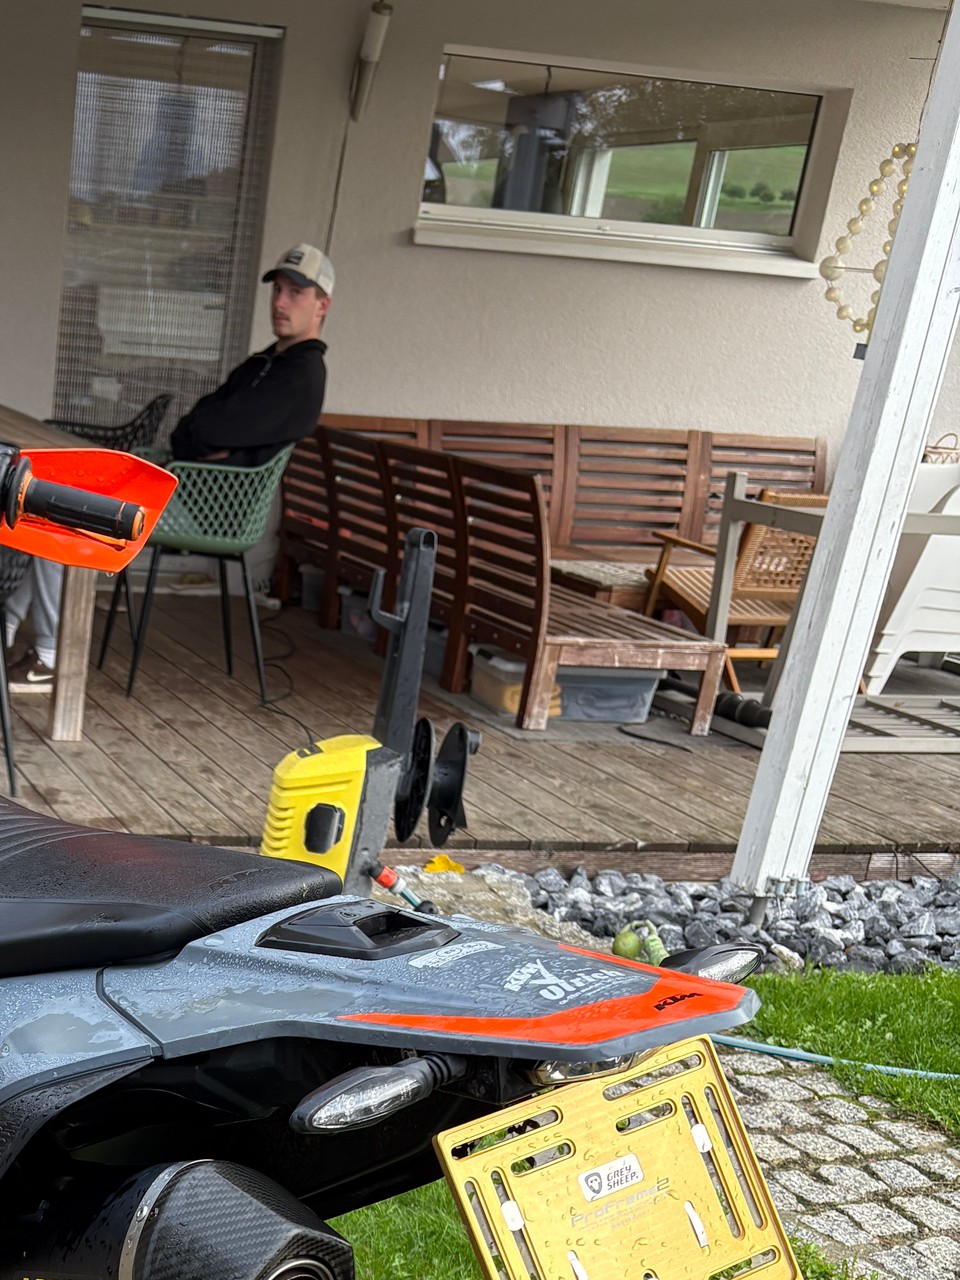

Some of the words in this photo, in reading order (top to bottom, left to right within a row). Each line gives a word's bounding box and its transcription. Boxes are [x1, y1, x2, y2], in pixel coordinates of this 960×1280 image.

[653, 992, 704, 1011] KTM
[606, 1164, 632, 1182] GREY
[606, 1171, 639, 1191] SHEEP.
